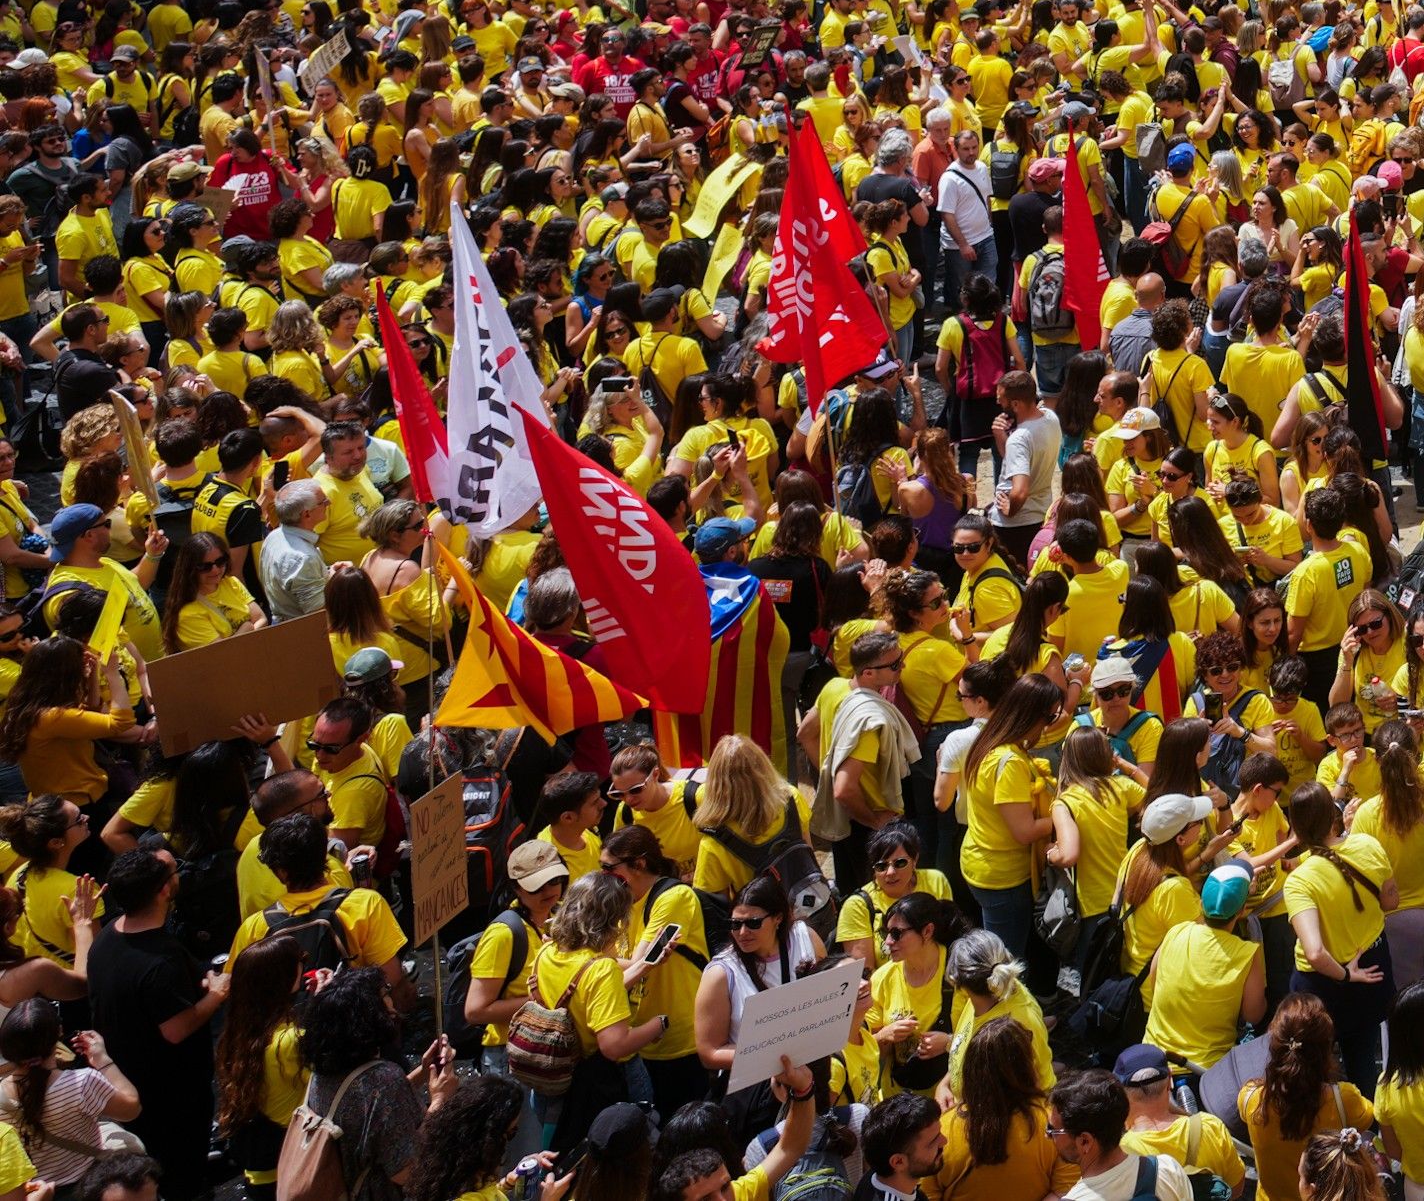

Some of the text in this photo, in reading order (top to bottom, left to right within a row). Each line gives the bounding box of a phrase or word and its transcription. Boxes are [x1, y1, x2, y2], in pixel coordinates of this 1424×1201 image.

[603, 75, 633, 87] 18/2
[1337, 559, 1350, 572] JO
[416, 806, 430, 835] NO
[754, 1009, 789, 1026] MOSSOS
[790, 1006, 796, 1014] A
[797, 1000, 812, 1010] LES
[739, 1033, 786, 1055] +EDUCACIÓ
[787, 1029, 797, 1039] AL
